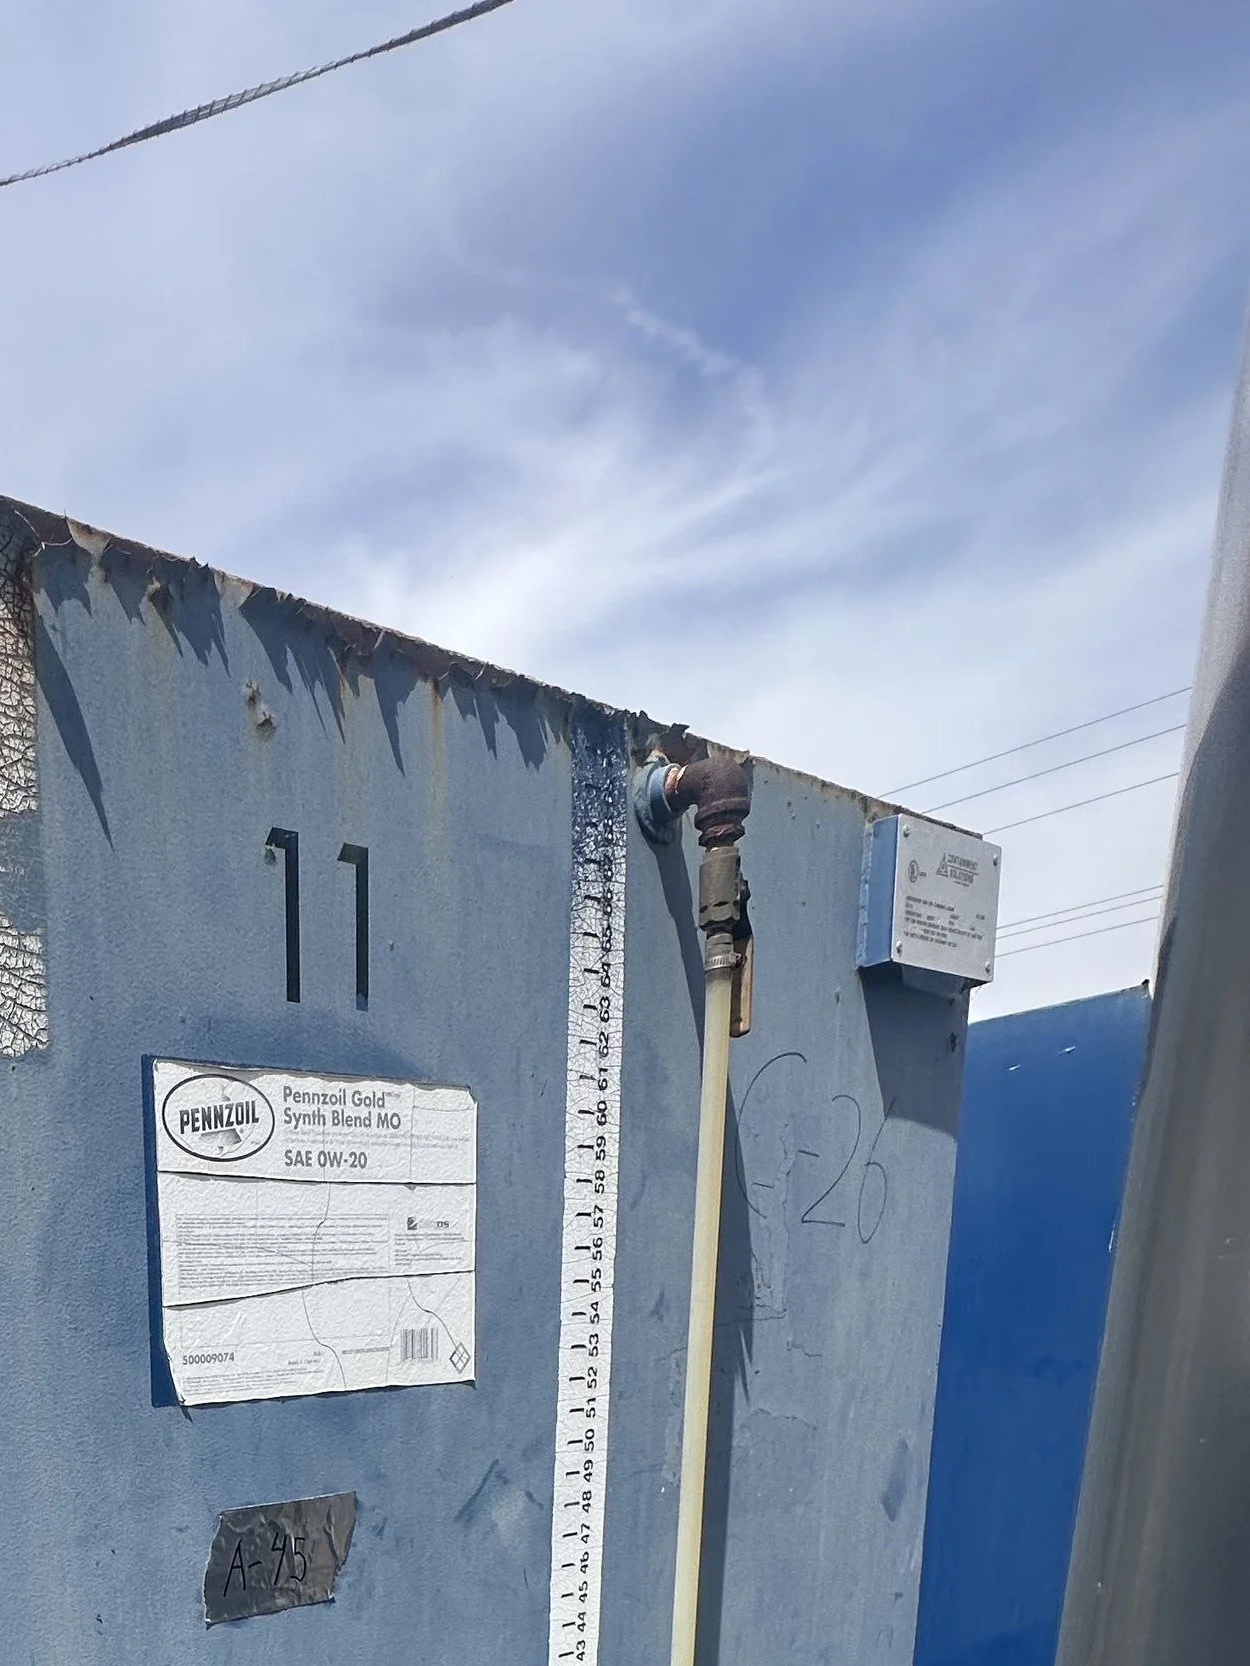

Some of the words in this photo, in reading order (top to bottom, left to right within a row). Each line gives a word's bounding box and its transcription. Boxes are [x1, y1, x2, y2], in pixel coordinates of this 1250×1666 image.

[265, 826, 369, 1012] 11
[601, 926, 612, 952] 65
[600, 962, 611, 988] 64
[599, 996, 610, 1023] 63
[598, 1031, 609, 1058] 62
[598, 1068, 608, 1091] 61
[283, 1086, 346, 1106] Pennzoil
[351, 1090, 386, 1109] Gold
[179, 1100, 260, 1134] PENNZOIL
[283, 1107, 327, 1130] Synth
[331, 1112, 372, 1128] Blend
[376, 1113, 401, 1130] MO
[596, 1100, 608, 1126] 60
[284, 1150, 313, 1168] SAE
[317, 1151, 368, 1169] 0W-20
[596, 1136, 606, 1161] 59
[594, 1170, 606, 1194] 58
[593, 1204, 604, 1228] 57
[592, 1237, 603, 1261] 56
[590, 1268, 602, 1292] 55
[589, 1301, 600, 1324] 54
[588, 1333, 599, 1357] 53
[182, 1352, 235, 1366] 500009074
[586, 1366, 598, 1389] 52
[585, 1398, 596, 1418] 51
[584, 1428, 594, 1452] 50
[583, 1460, 593, 1483] 49
[582, 1490, 592, 1514] 48
[580, 1524, 591, 1544] 47
[223, 1532, 307, 1598] A-45
[580, 1551, 590, 1574] 46
[578, 1581, 588, 1603] 45
[577, 1612, 586, 1632] 44
[576, 1640, 586, 1662] 43
